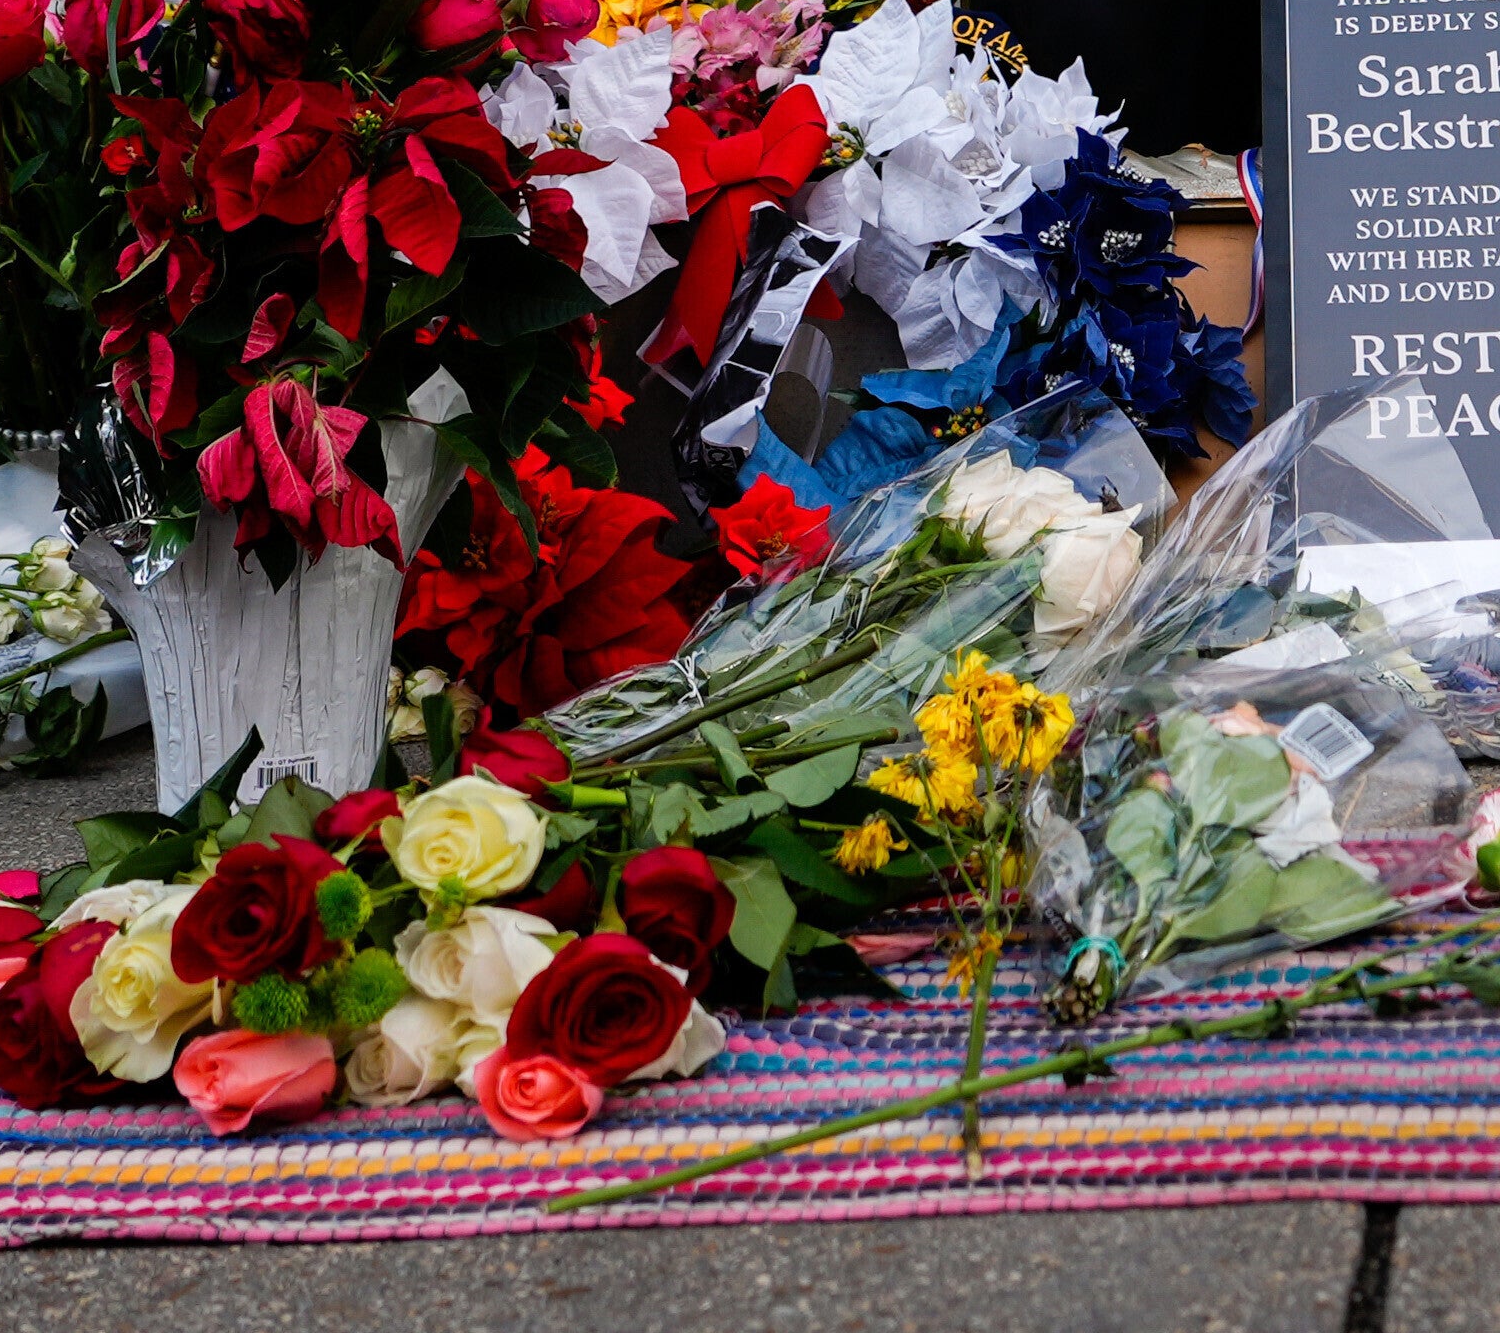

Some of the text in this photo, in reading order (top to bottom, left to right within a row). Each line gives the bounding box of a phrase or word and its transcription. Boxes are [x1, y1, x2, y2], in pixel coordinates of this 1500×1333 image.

[1333, 16, 1361, 36] IS
[1368, 12, 1477, 34] DEEPLY
[1348, 187, 1400, 208] WE
[1324, 250, 1409, 272] WITH
[1414, 248, 1476, 270] HER
[1325, 283, 1391, 305] AND
[1397, 280, 1496, 303] LOVED
